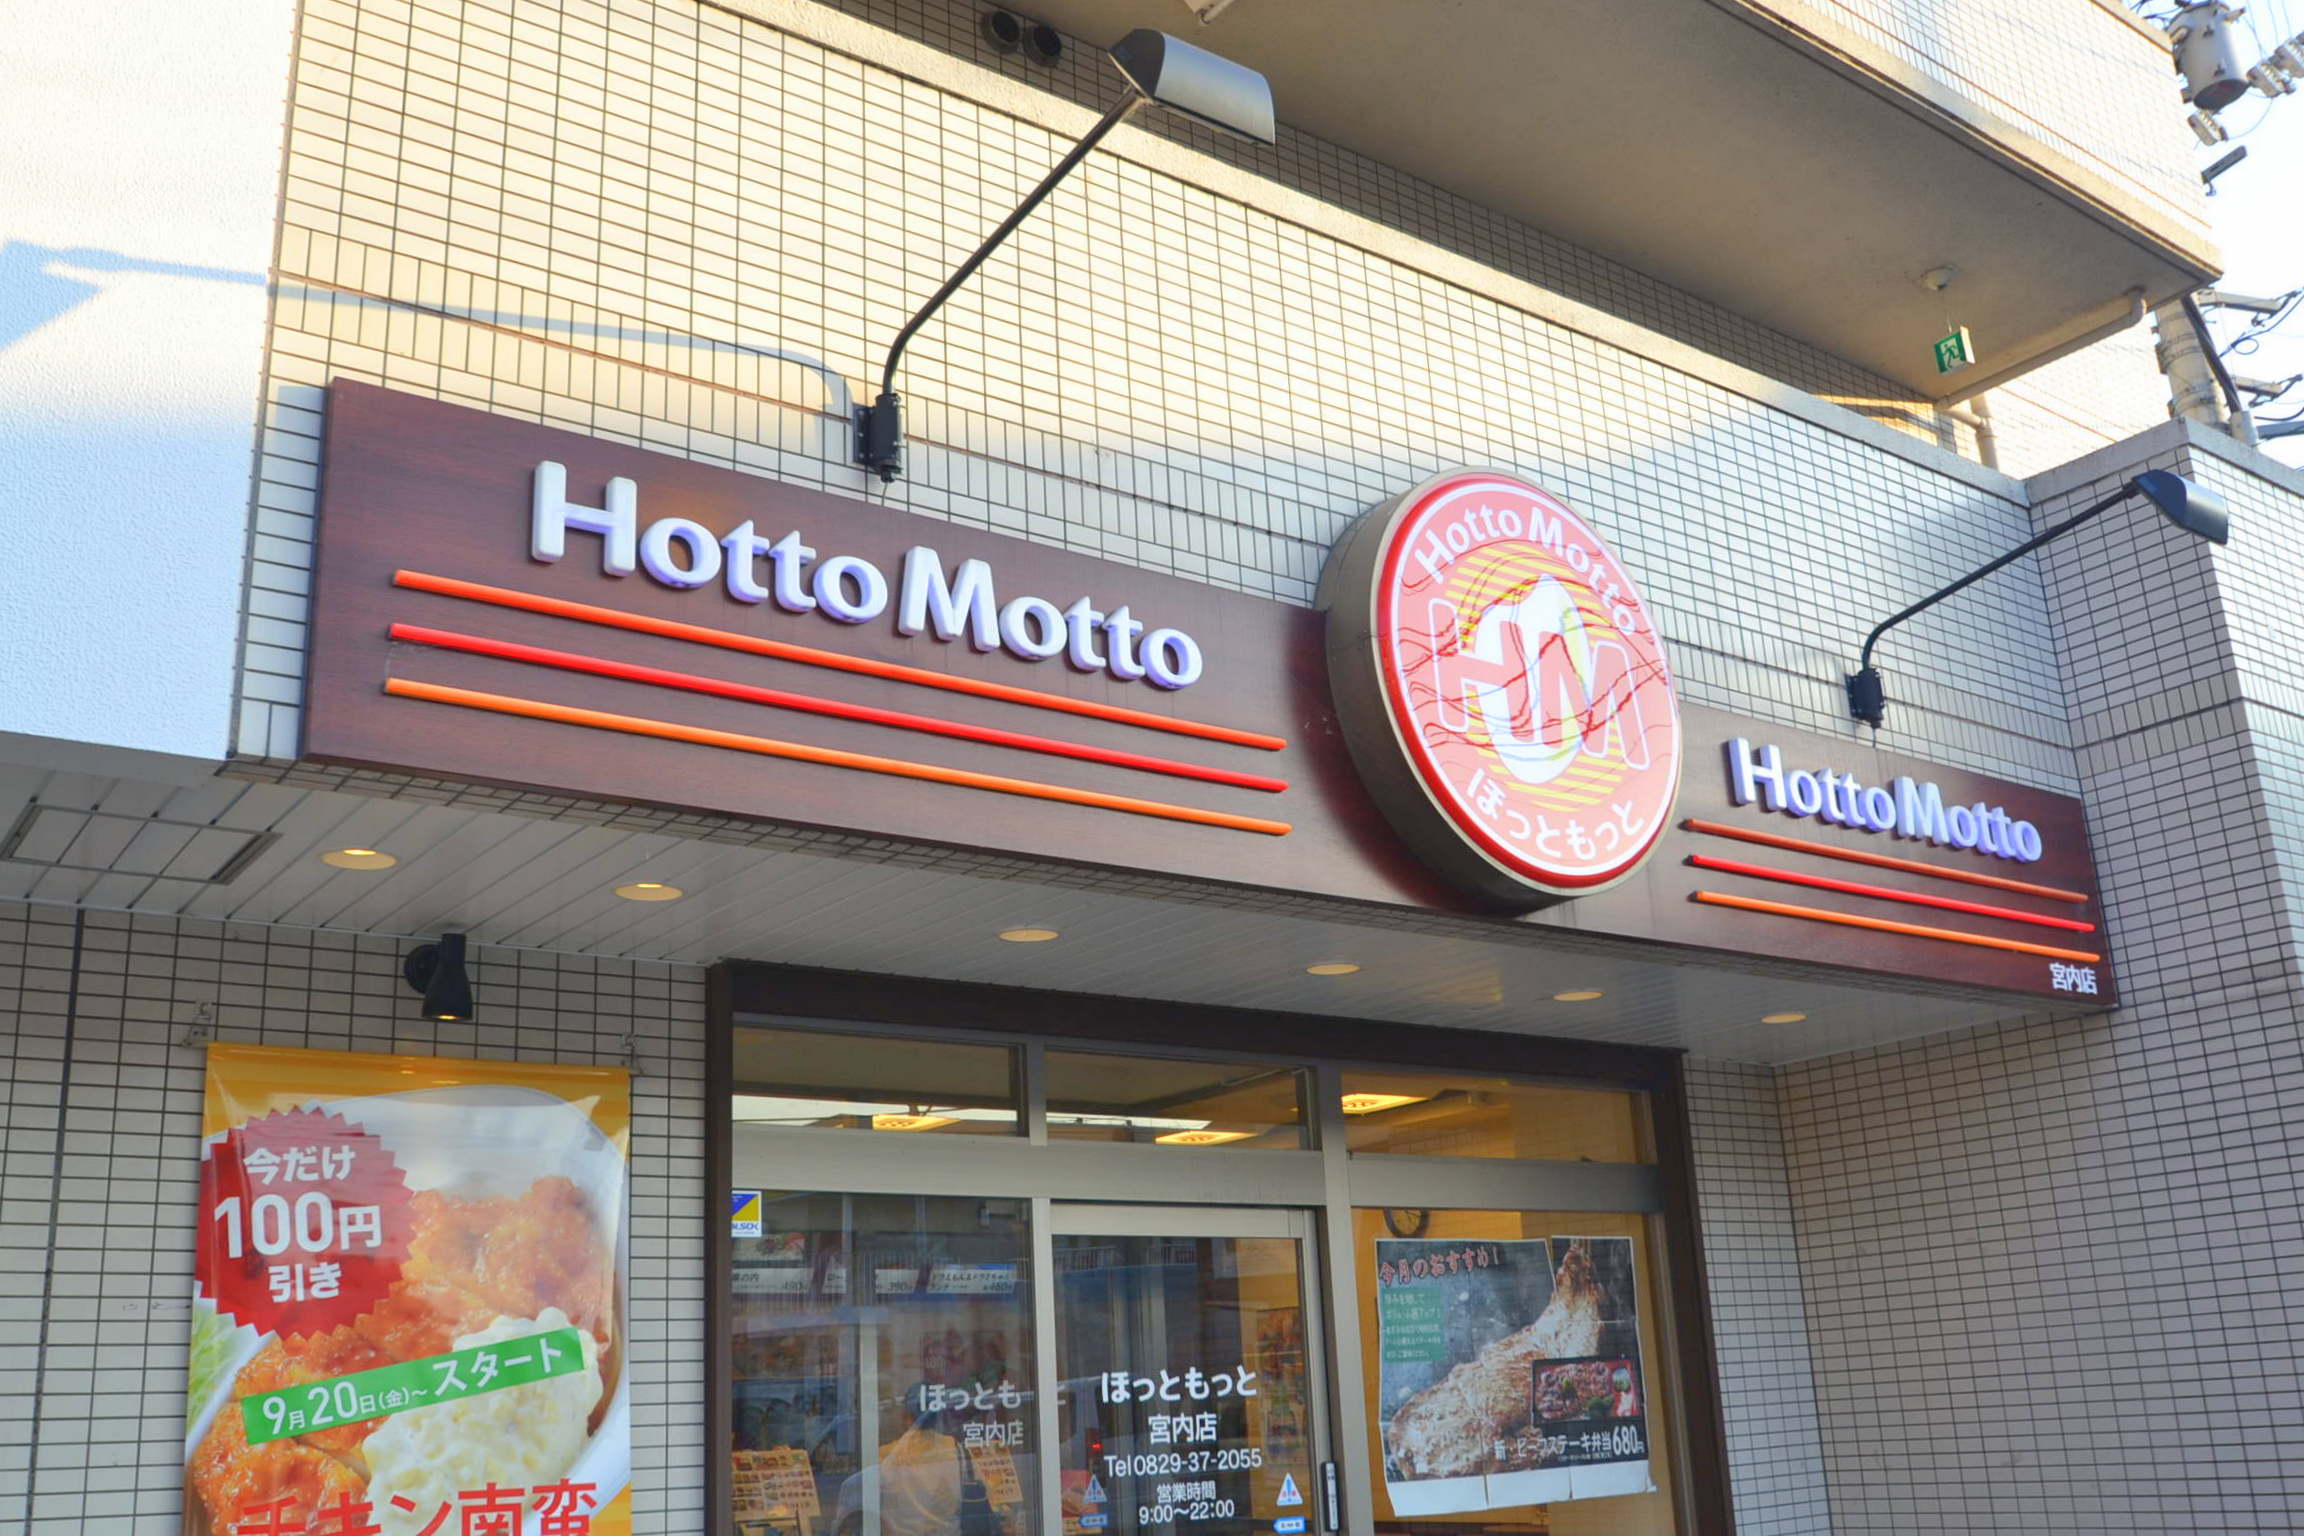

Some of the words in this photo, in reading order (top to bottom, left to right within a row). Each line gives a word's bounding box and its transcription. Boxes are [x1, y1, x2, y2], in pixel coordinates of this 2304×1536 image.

[531, 461, 888, 625] Hotto
[897, 545, 1203, 690] Motto
[1414, 504, 1523, 584] Hotto
[1528, 507, 1636, 637] Motto
[1466, 768, 1645, 861] ほっともっと
[1727, 737, 1897, 833] Hotto
[1893, 776, 2043, 863] Motto
[2049, 962, 2098, 995] 宮内店
[243, 1145, 356, 1185] 今だけ
[213, 1191, 383, 1259] 100円
[267, 1262, 342, 1302] 引き
[1101, 1365, 1257, 1403] ほっともっと
[962, 1419, 1024, 1448] 宮内店
[1148, 1411, 1217, 1444] 宮内店
[1156, 1480, 1217, 1504] 営業時間
[1139, 1500, 1235, 1525] 9:00〜22:00
